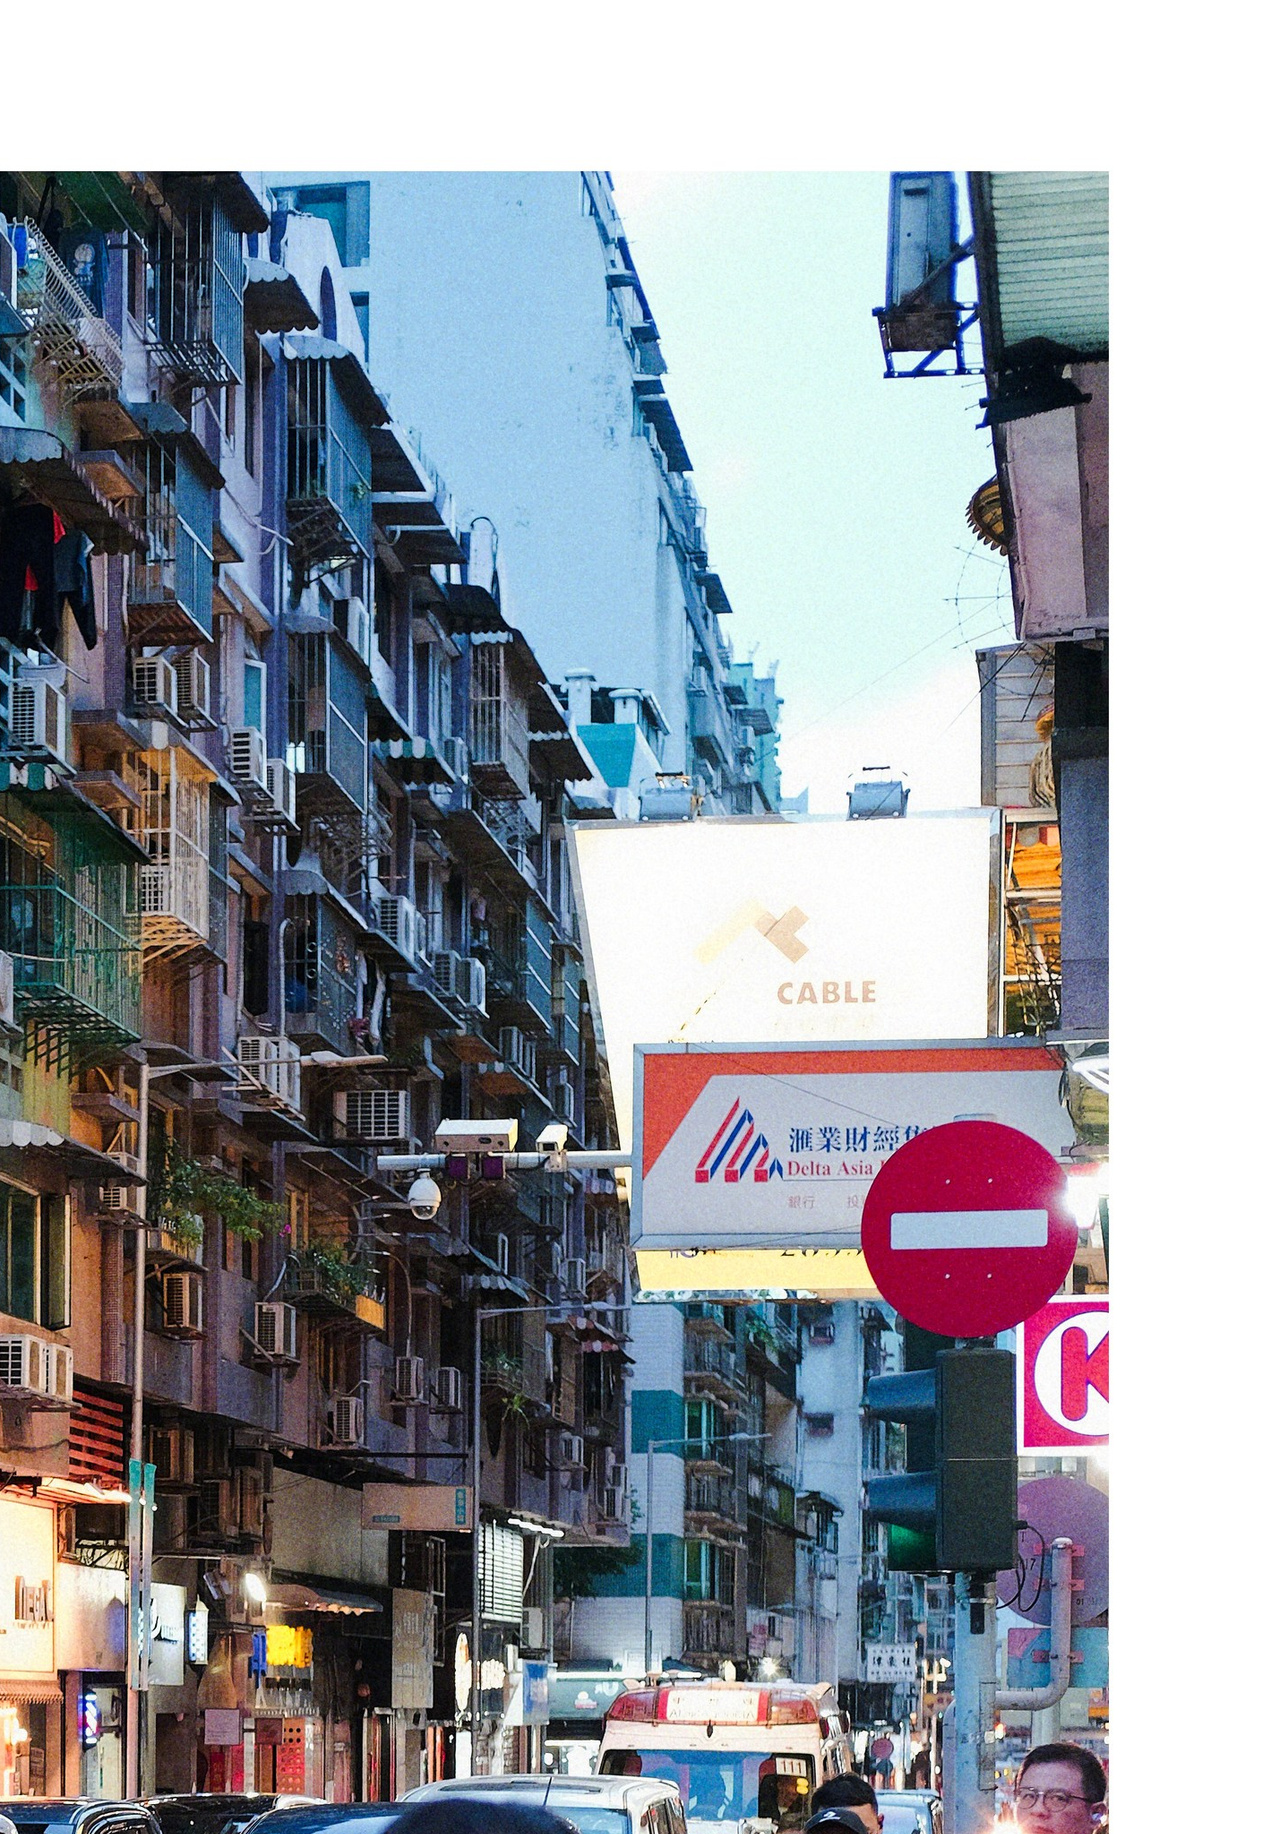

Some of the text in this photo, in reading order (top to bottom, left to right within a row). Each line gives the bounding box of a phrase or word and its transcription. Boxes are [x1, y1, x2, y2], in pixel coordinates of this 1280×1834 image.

[777, 980, 876, 1005] CABLE
[788, 1160, 830, 1176] Delta
[837, 1160, 873, 1176] Asia
[1061, 1326, 1110, 1422] K
[781, 1760, 805, 1775] 111
